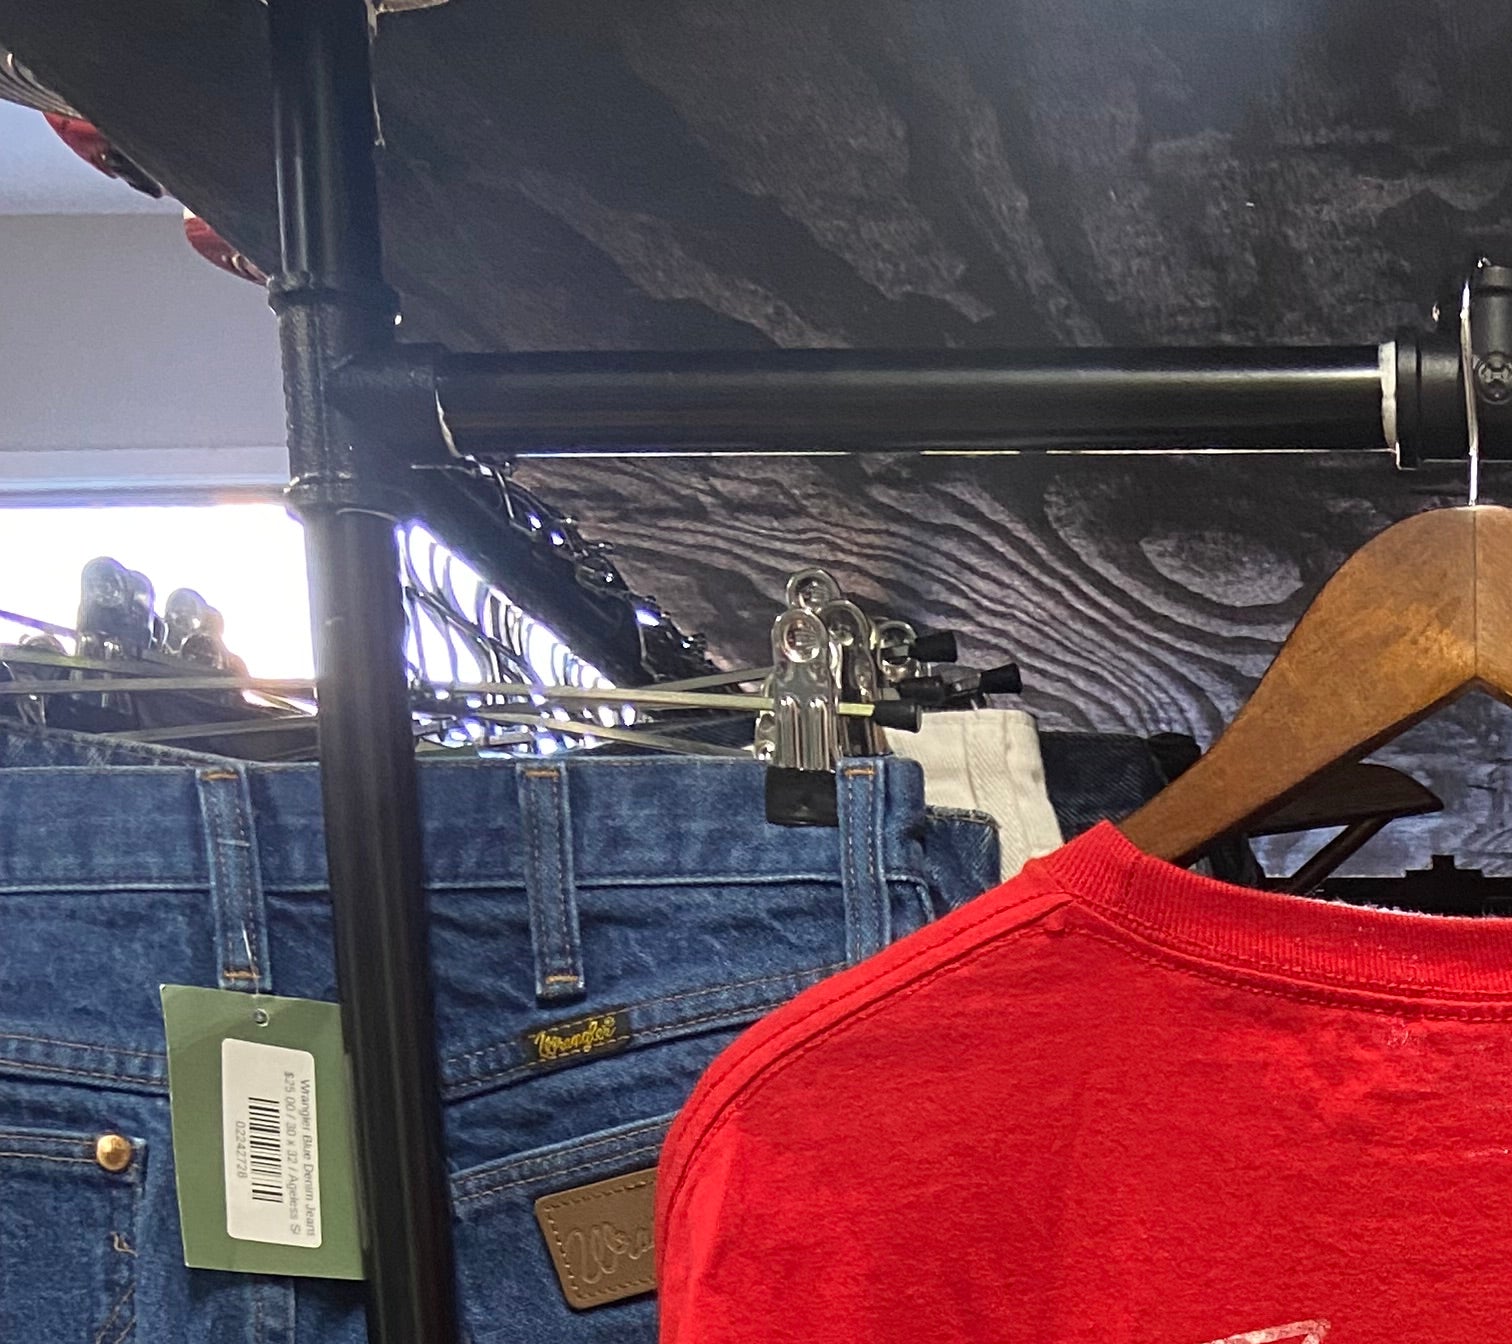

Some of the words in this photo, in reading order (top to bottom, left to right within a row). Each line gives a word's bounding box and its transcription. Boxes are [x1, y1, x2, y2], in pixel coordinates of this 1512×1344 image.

[534, 1020, 616, 1059] Wrangler
[300, 1079, 311, 1131] Wrangler
[303, 1135, 313, 1160] Blue
[304, 1163, 314, 1201] Denim
[305, 1204, 316, 1236] Jeans
